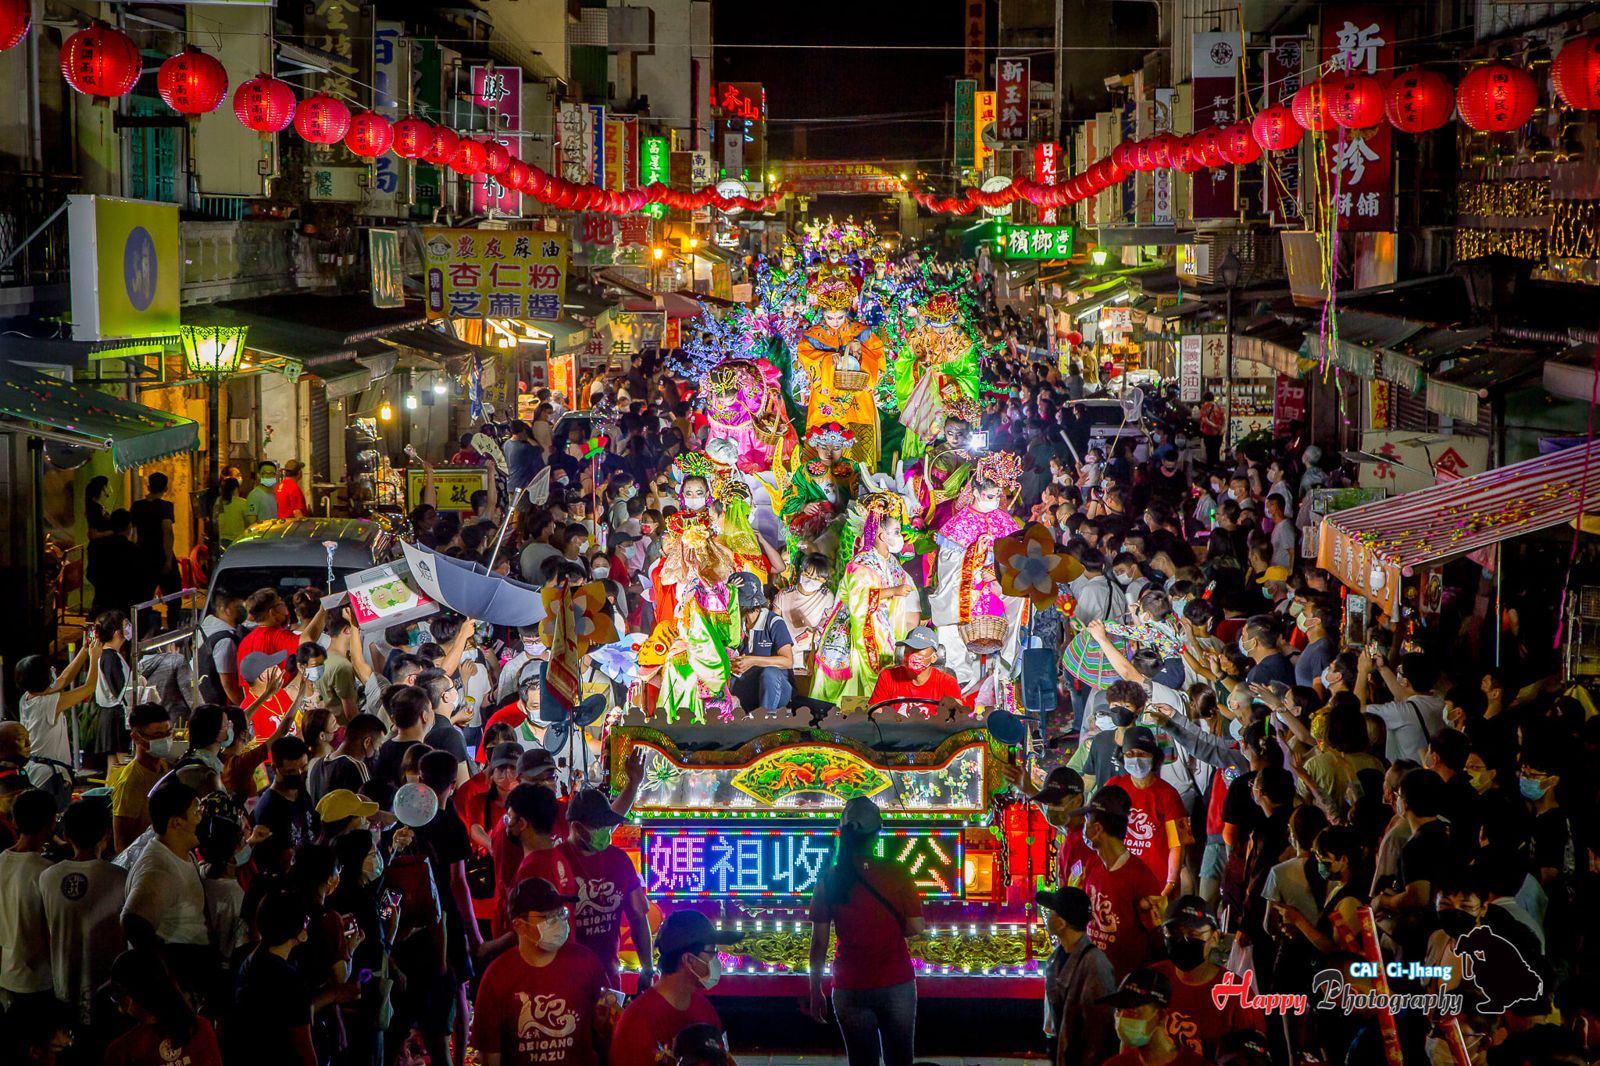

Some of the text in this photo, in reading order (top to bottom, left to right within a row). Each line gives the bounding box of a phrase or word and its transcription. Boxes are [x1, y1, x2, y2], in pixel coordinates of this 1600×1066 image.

[1000, 61, 1024, 125] 新玉珍
[1009, 229, 1052, 255] 檳榔
[1056, 230, 1070, 255] 海口
[448, 261, 562, 289] 杏仁粉
[650, 836, 951, 893] 媽祖收公
[518, 1037, 574, 1052] BEIGANG
